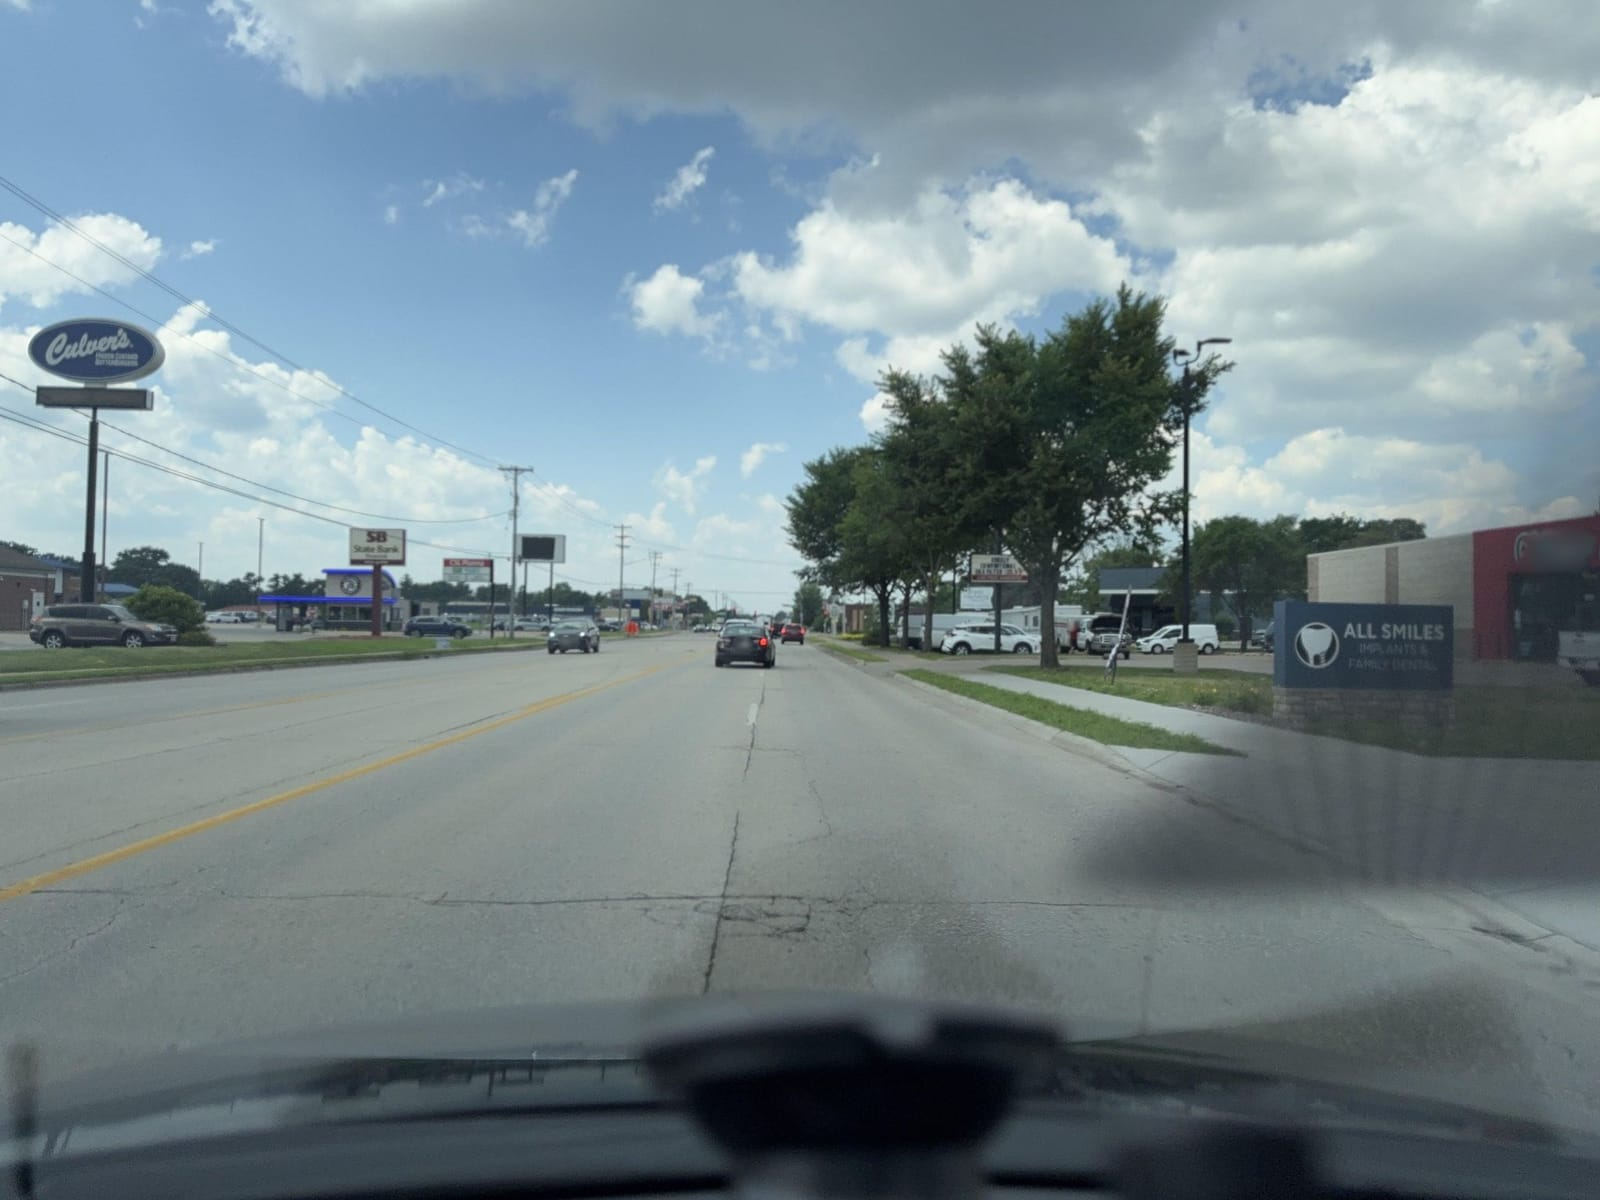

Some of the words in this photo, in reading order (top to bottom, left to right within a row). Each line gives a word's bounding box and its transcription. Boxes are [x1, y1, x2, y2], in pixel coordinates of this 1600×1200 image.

[45, 328, 131, 366] Culver's
[353, 544, 375, 553] State
[376, 544, 398, 553] Bank
[1343, 622, 1377, 639] ALL
[1381, 623, 1445, 641] SMILES
[1359, 643, 1418, 656] IMPLANTS
